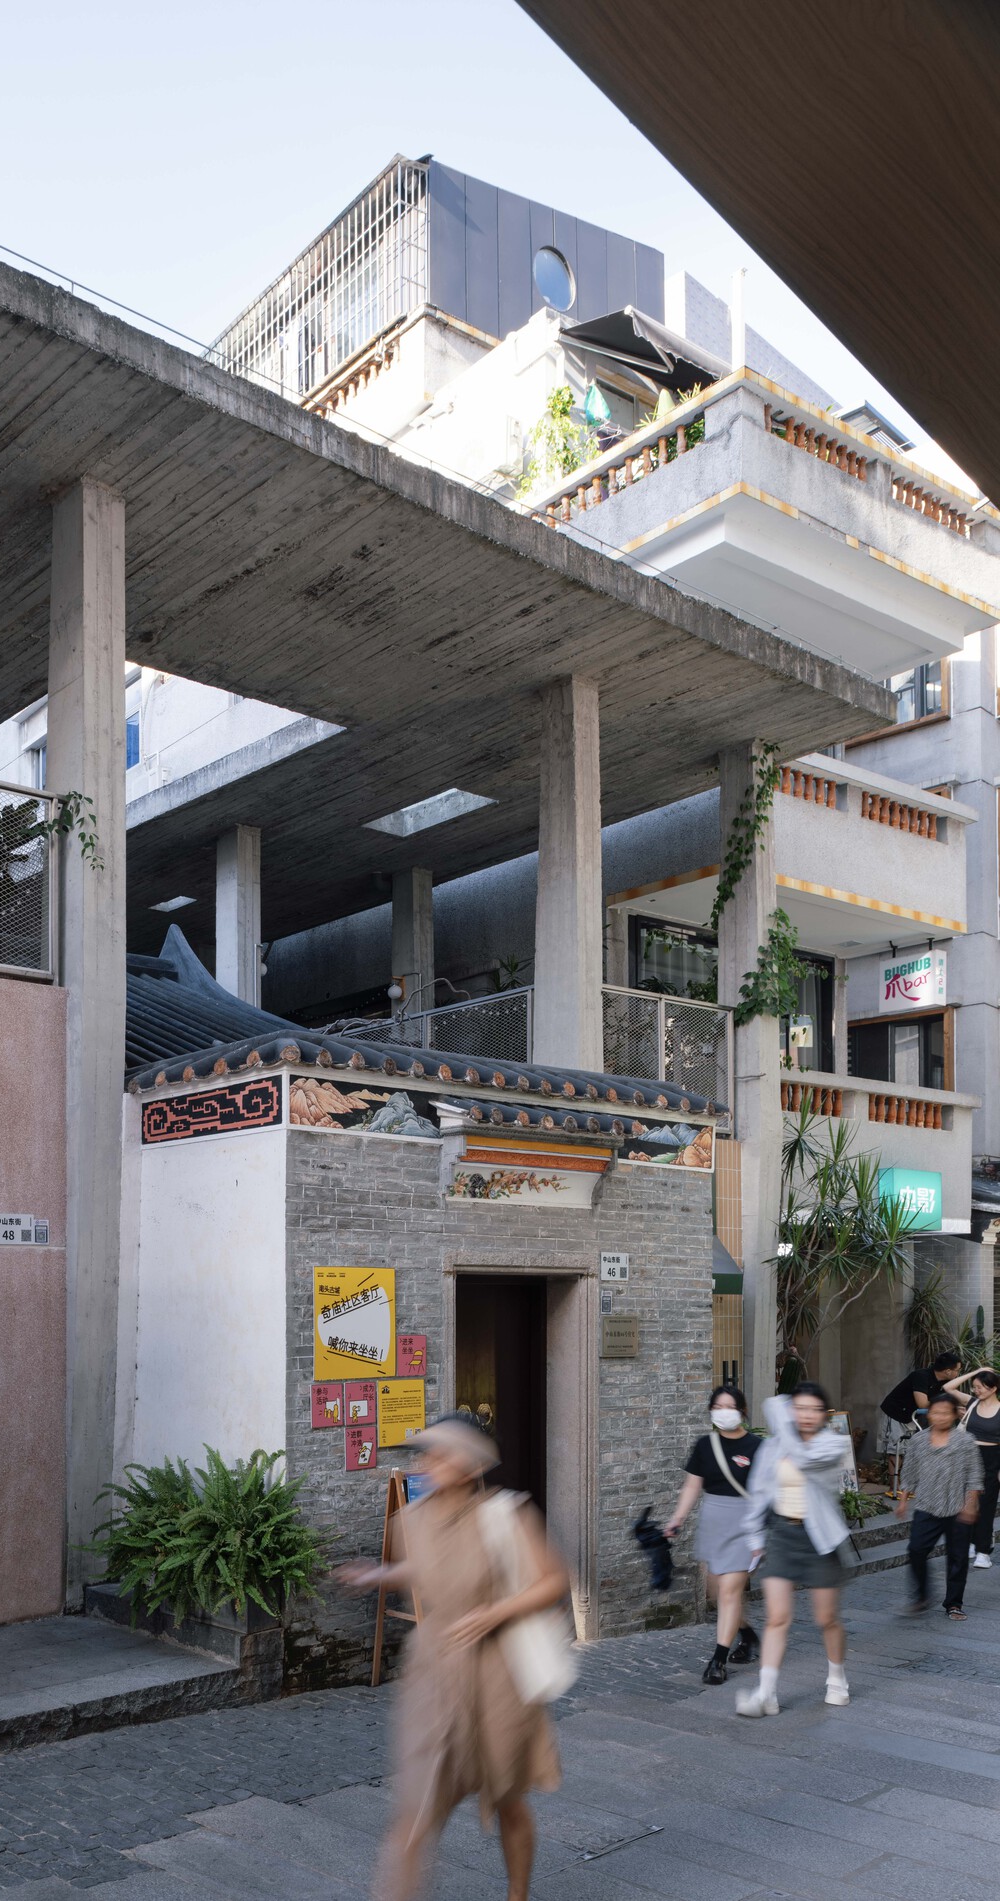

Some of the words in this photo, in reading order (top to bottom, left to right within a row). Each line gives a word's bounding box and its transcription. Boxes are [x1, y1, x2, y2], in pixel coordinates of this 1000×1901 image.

[884, 957, 931, 981] BUGHUB
[2, 1230, 15, 1240] 48
[607, 1267, 616, 1277] 46
[320, 1283, 380, 1320] 奇庙社区客厅
[316, 1387, 328, 1396] 参与
[362, 1384, 374, 1393] 成为
[316, 1396, 328, 1406] 活动
